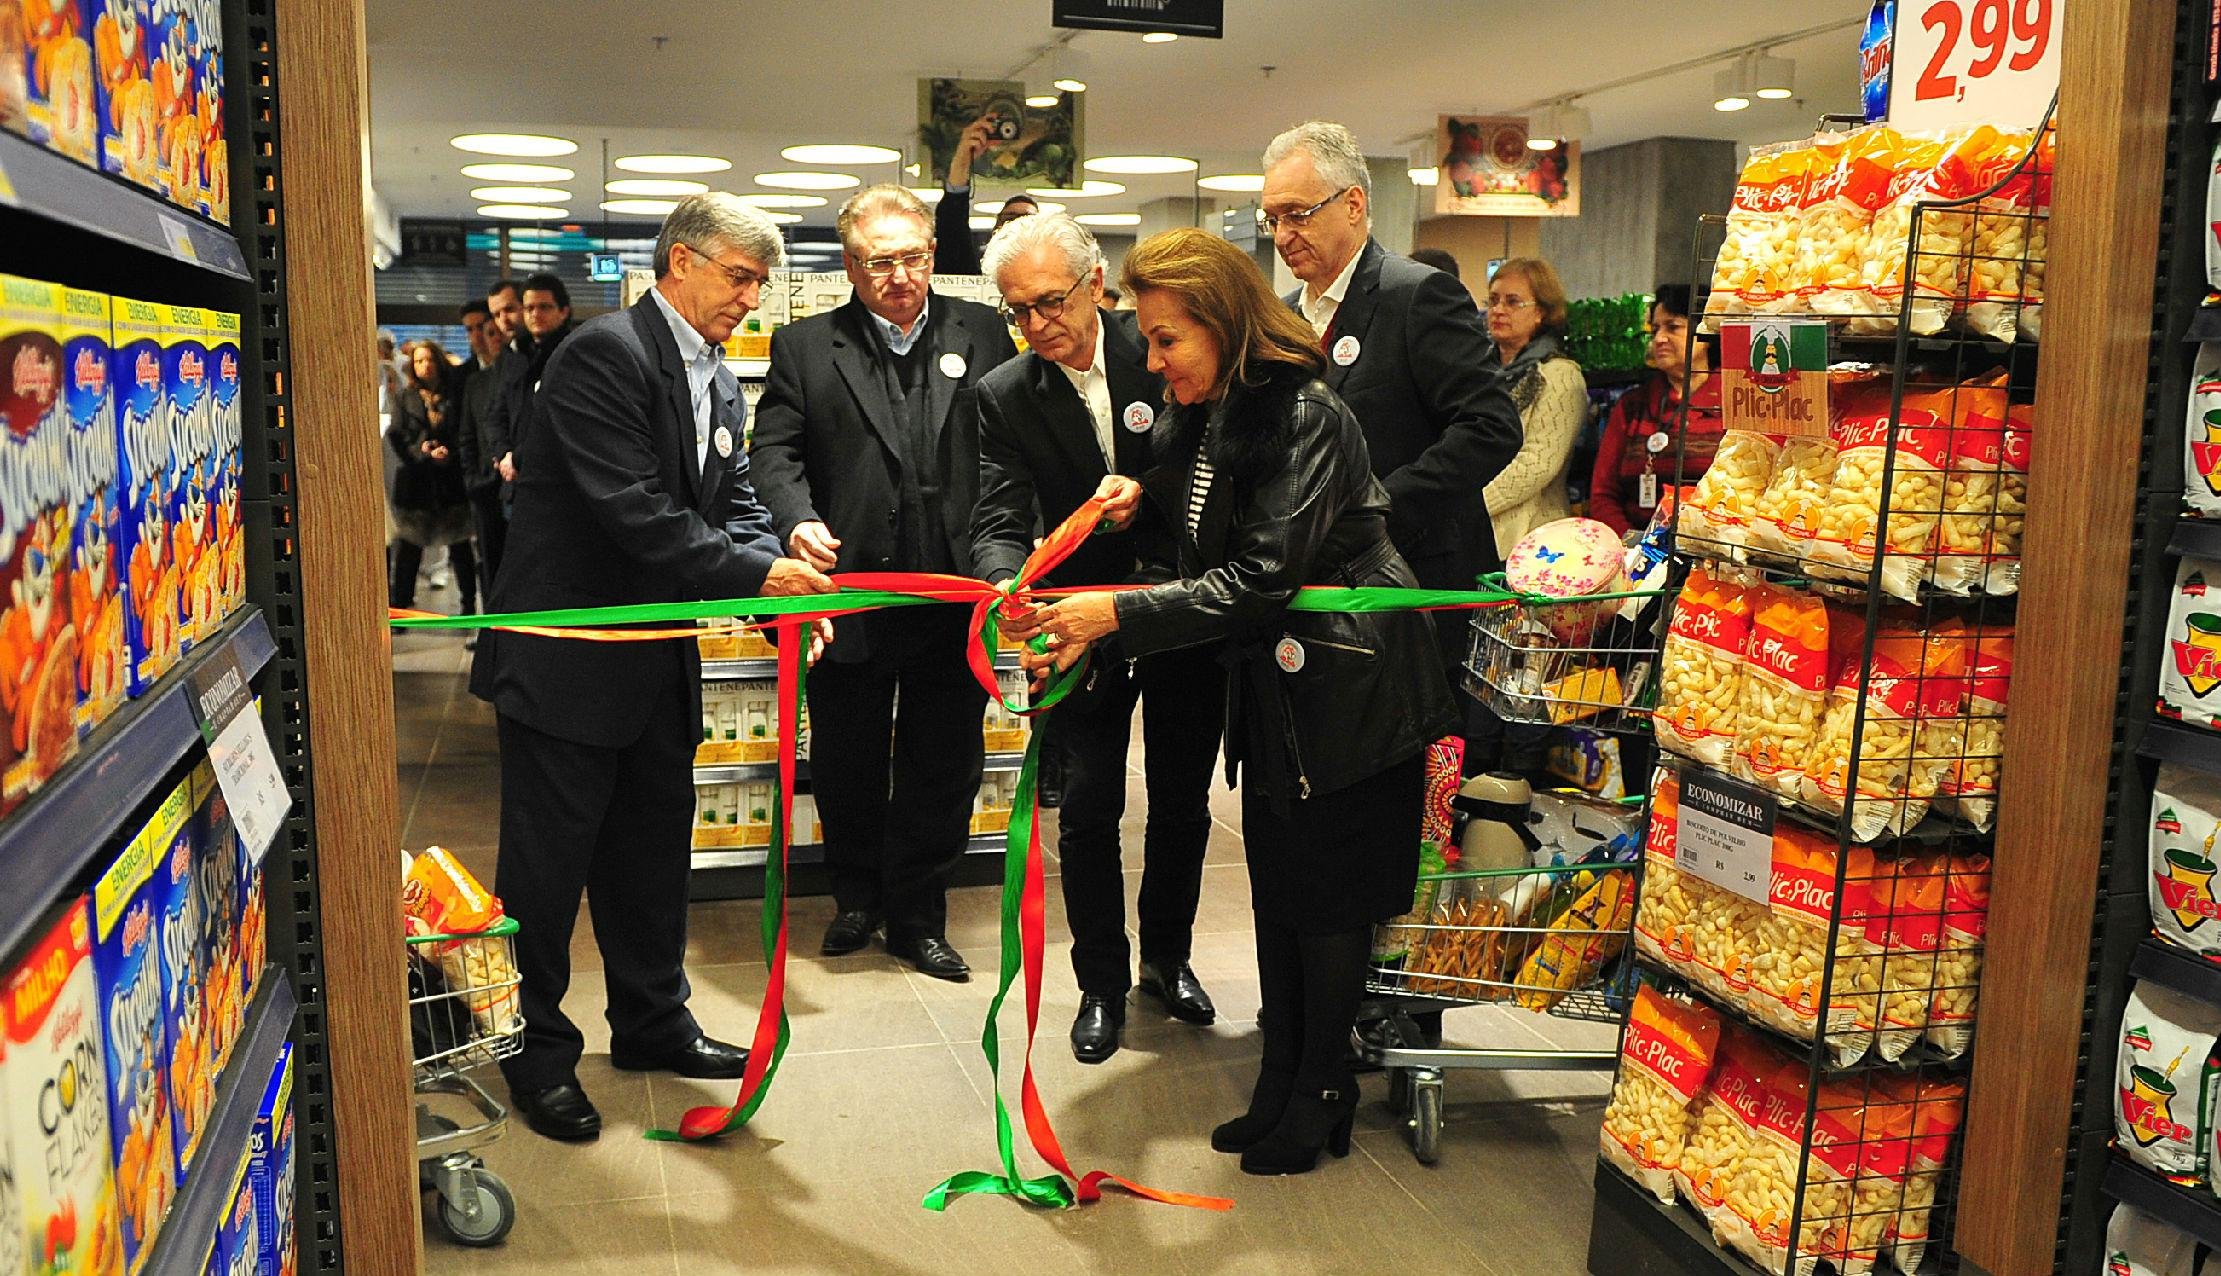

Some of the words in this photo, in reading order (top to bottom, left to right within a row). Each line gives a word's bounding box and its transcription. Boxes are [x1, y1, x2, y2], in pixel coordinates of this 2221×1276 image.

[1915, 0, 2051, 103] 2,99
[810, 273, 848, 284] PANTE
[65, 291, 103, 316] ENERGIA
[127, 301, 158, 322] ENERGIA
[170, 306, 202, 326] ENERGIA
[1687, 782, 1763, 822] ECONOMIZAR
[111, 839, 146, 892] ENERGIA
[14, 948, 69, 1026] MILHO
[37, 1021, 98, 1138] CORN
[2119, 1083, 2193, 1145] Vier
